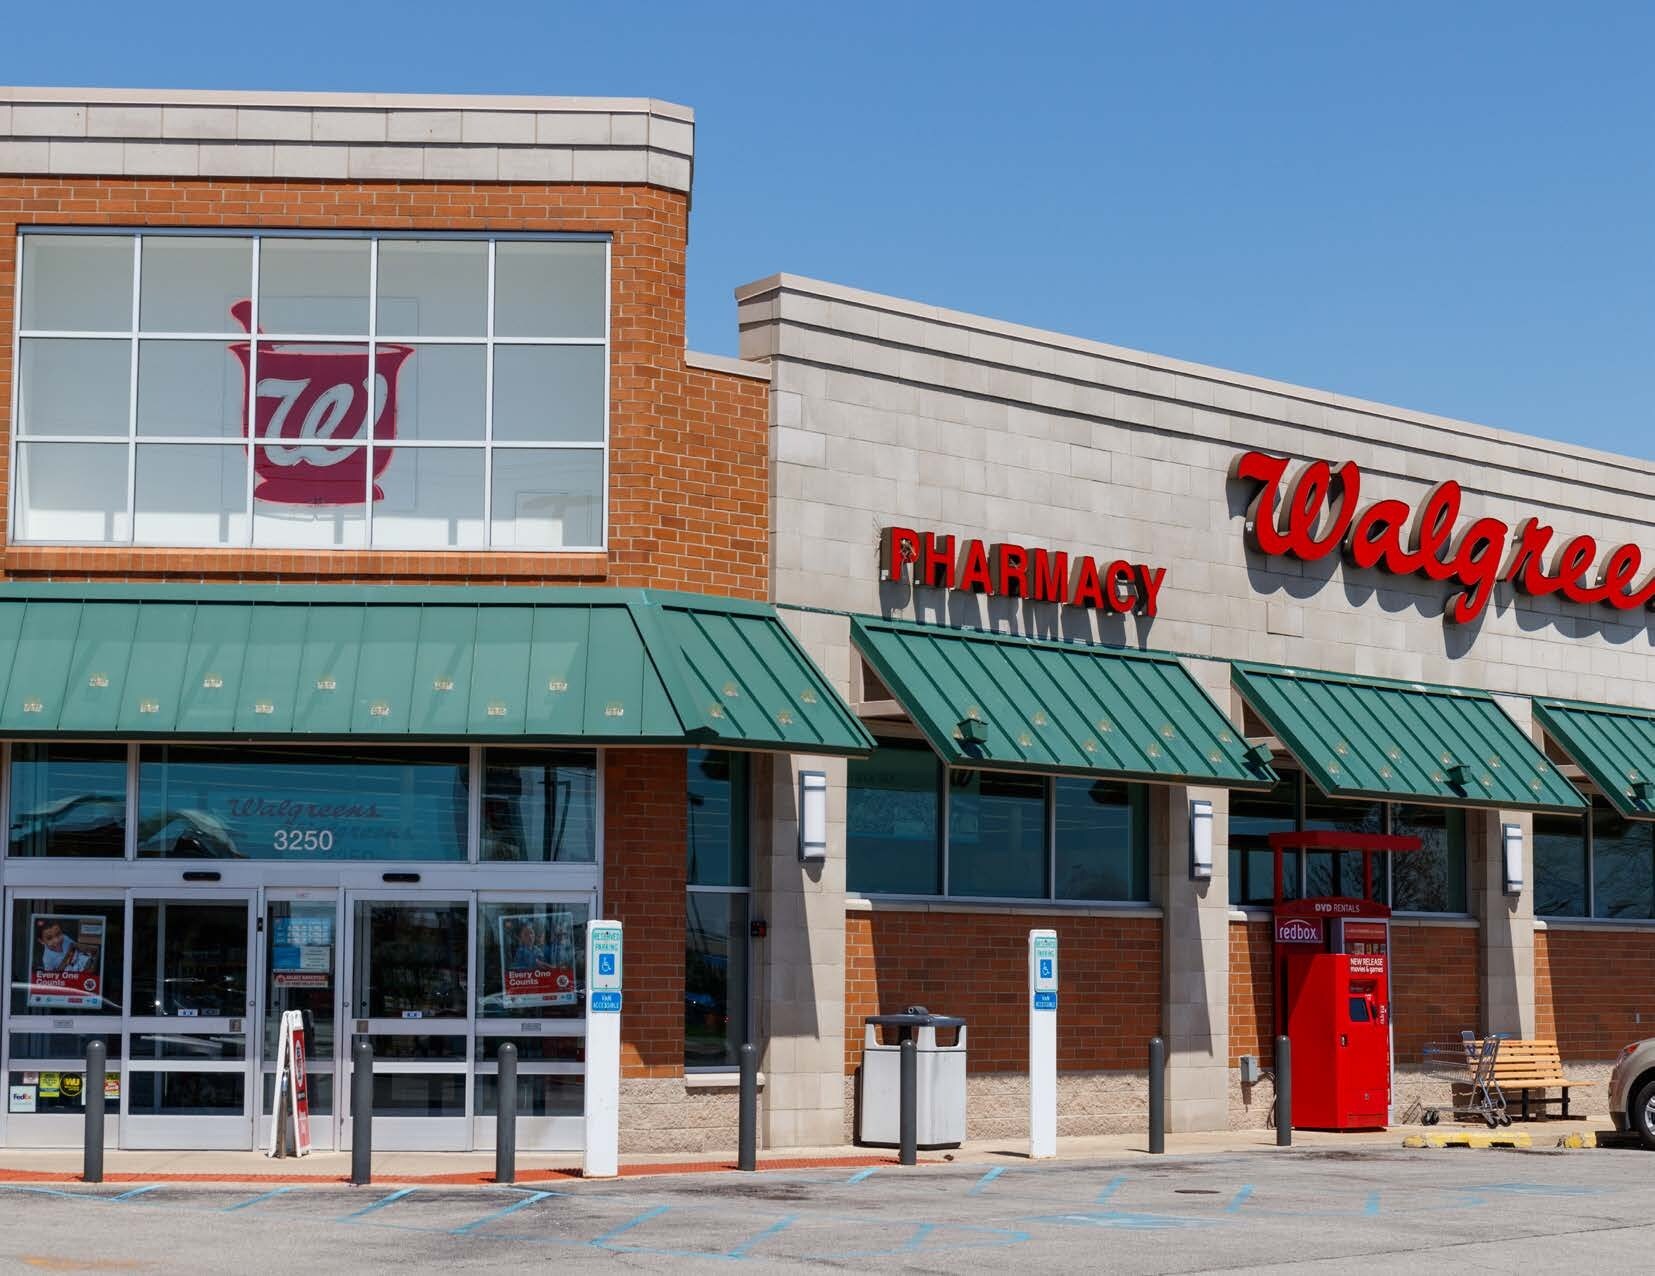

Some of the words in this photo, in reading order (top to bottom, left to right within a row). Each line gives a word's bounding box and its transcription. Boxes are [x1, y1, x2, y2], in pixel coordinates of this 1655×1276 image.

[883, 526, 1167, 617] PHARMACY
[228, 797, 384, 826] Walgreens
[273, 830, 334, 850] 3250
[1314, 903, 1333, 912] DVD
[1333, 904, 1360, 913] RENTALS
[1279, 923, 1319, 940] redbox
[1350, 957, 1363, 966] NEW
[1363, 957, 1383, 966] RELEASE
[36, 970, 59, 979] Every
[62, 971, 79, 979] One
[509, 971, 532, 979] Every
[1369, 966, 1383, 974] games
